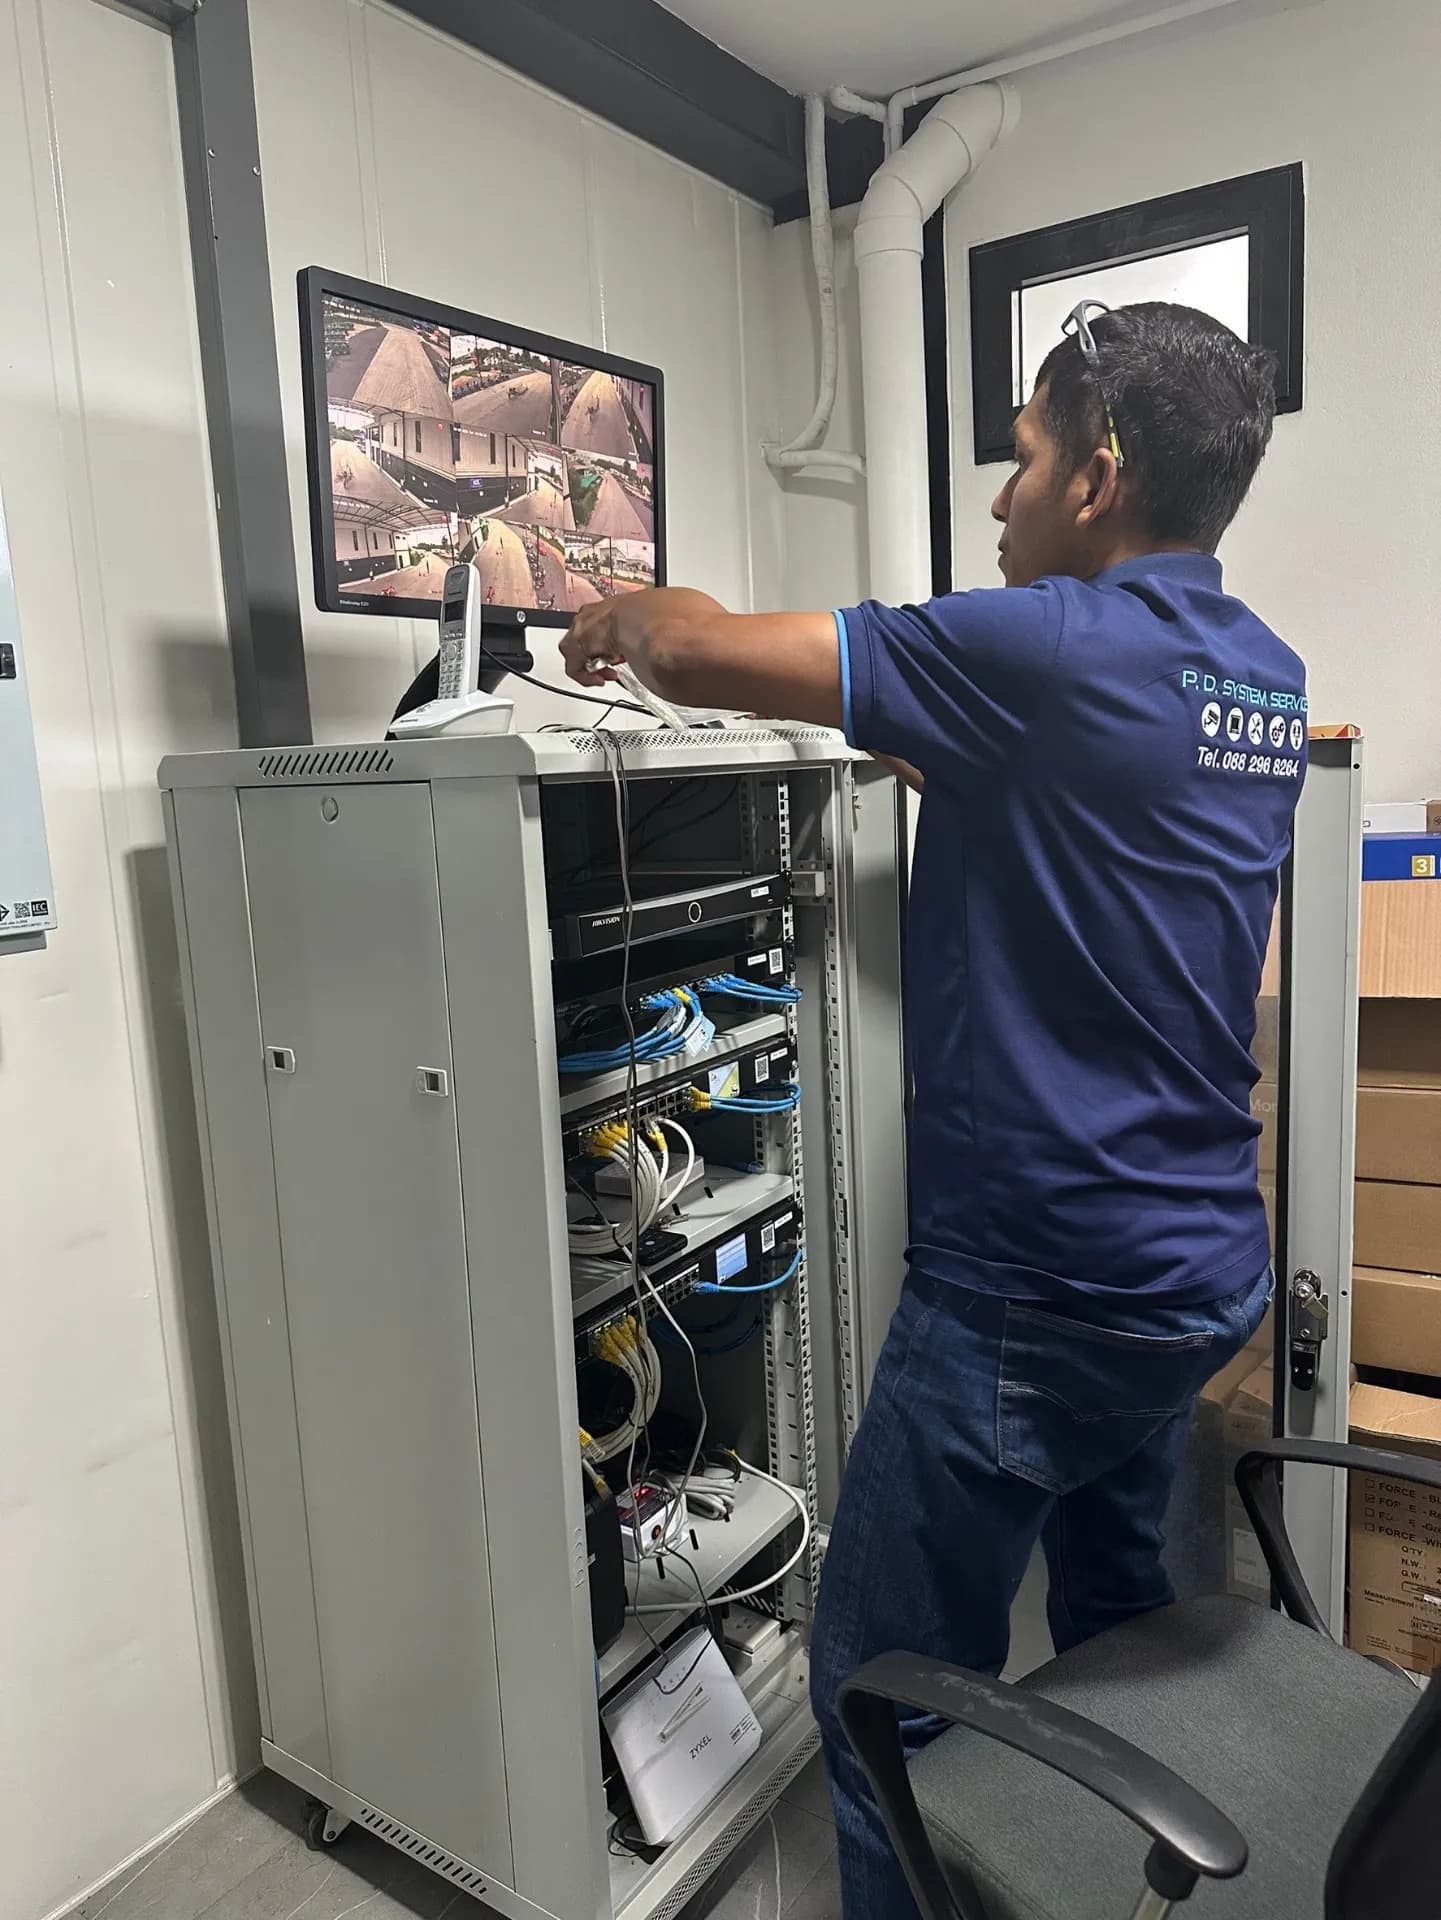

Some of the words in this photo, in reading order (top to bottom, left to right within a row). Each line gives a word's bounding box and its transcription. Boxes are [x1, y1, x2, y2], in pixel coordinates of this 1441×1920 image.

[1222, 679, 1268, 707] SYSTEM
[1198, 746, 1220, 769] Tel.
[1415, 858, 1428, 874] 3
[32, 902, 47, 912] IEC
[1379, 1482, 1417, 1499] FORCE
[1379, 1497, 1417, 1514] FORE
[1379, 1526, 1417, 1542] FORCE
[689, 1735, 712, 1759] ZYXEL
